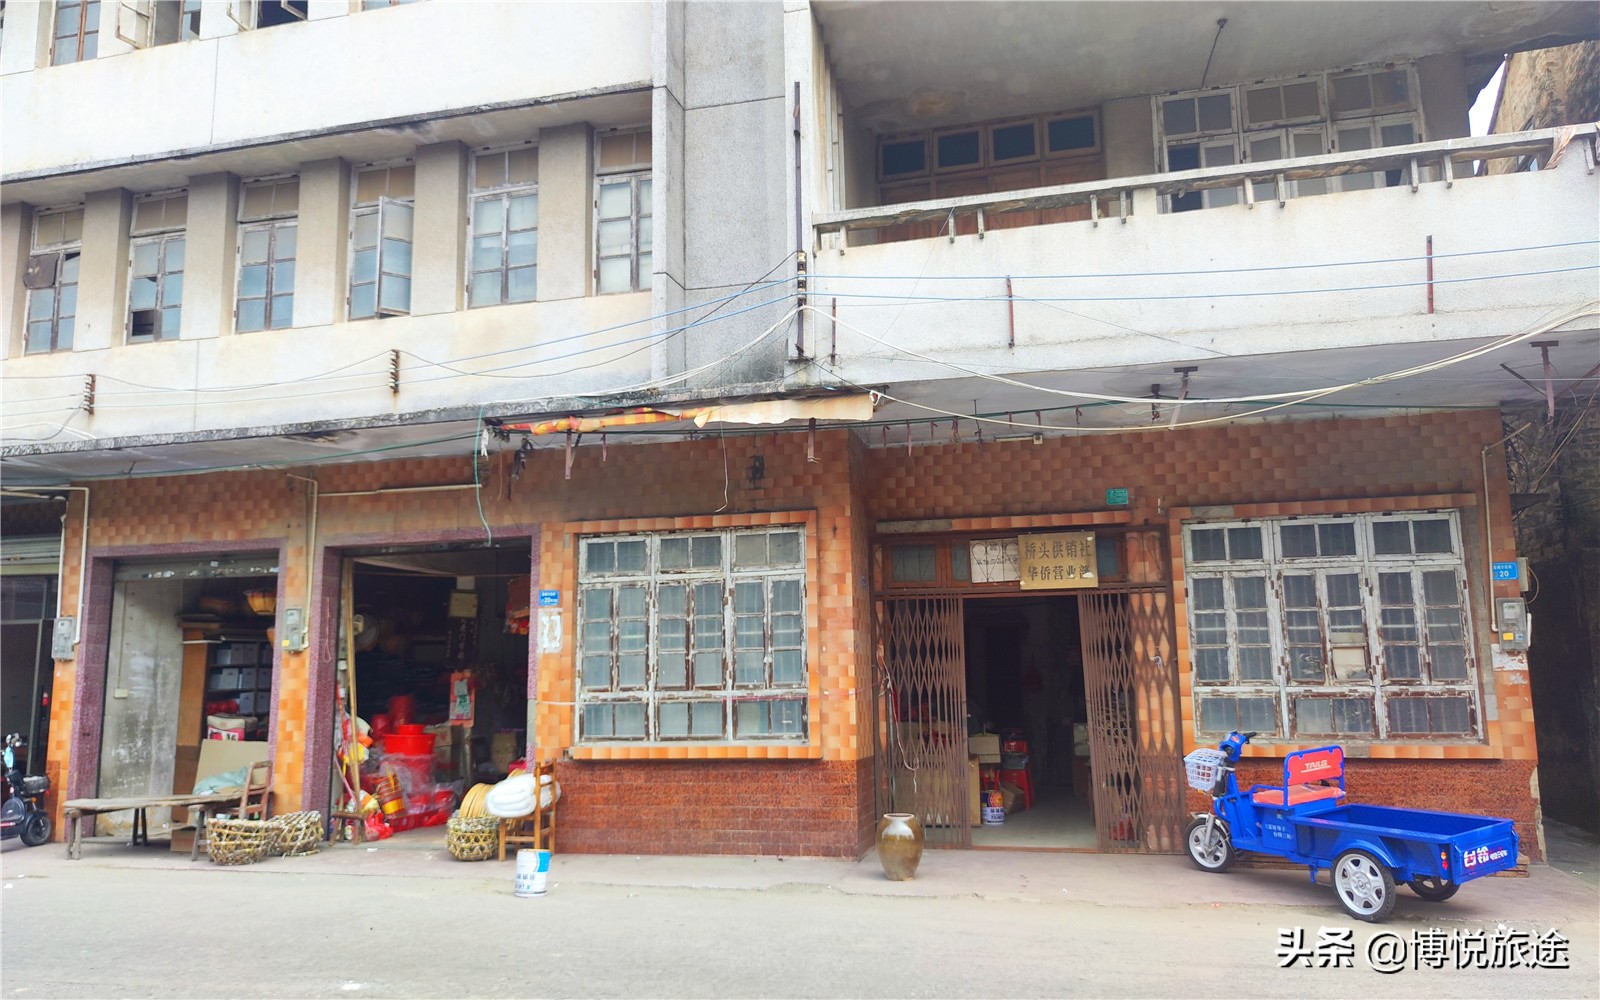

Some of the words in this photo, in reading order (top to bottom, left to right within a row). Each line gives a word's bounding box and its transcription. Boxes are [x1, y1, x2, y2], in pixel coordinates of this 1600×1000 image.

[1025, 541, 1091, 559] 桥头供销社
[1028, 564, 1092, 580] 华侨营业部
[1499, 570, 1509, 578] 20
